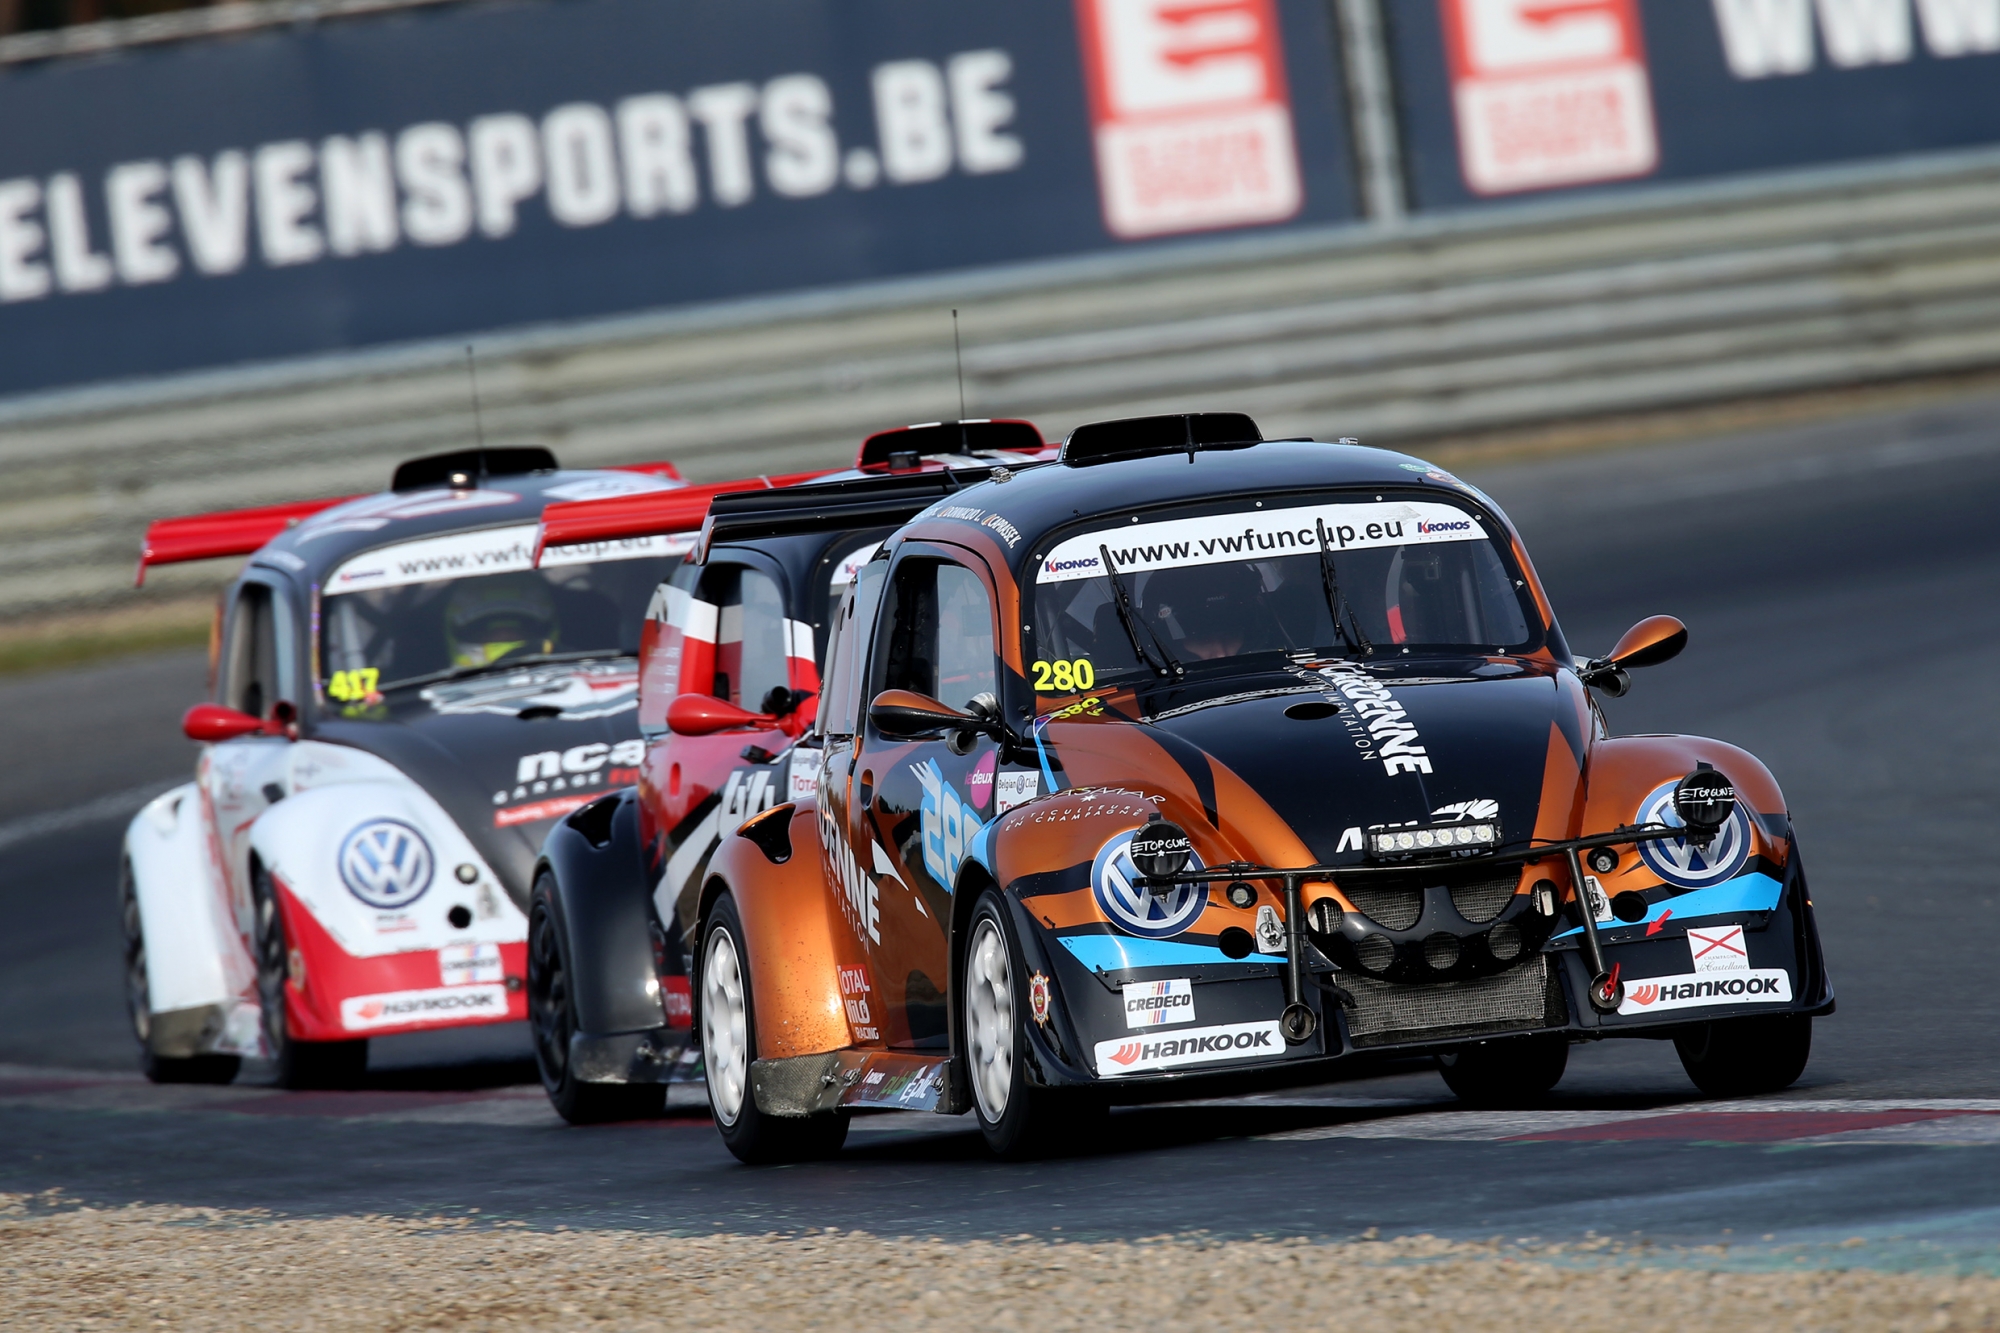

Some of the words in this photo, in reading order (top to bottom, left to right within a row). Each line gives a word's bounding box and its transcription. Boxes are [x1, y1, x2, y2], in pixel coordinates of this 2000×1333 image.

[0, 46, 1025, 302] ELEVENSPORTS.BE
[1417, 517, 1471, 534] KRONOS
[1112, 520, 1404, 567] www.vwfuncup.eu
[1045, 556, 1099, 573] KRONOS
[329, 666, 380, 702] 417
[1032, 659, 1095, 691] 280
[1692, 787, 1710, 798] TOP
[1711, 787, 1728, 796] GUN
[1143, 840, 1165, 851] TOP
[1165, 838, 1186, 849] GUN
[1127, 993, 1191, 1013] CREDECO
